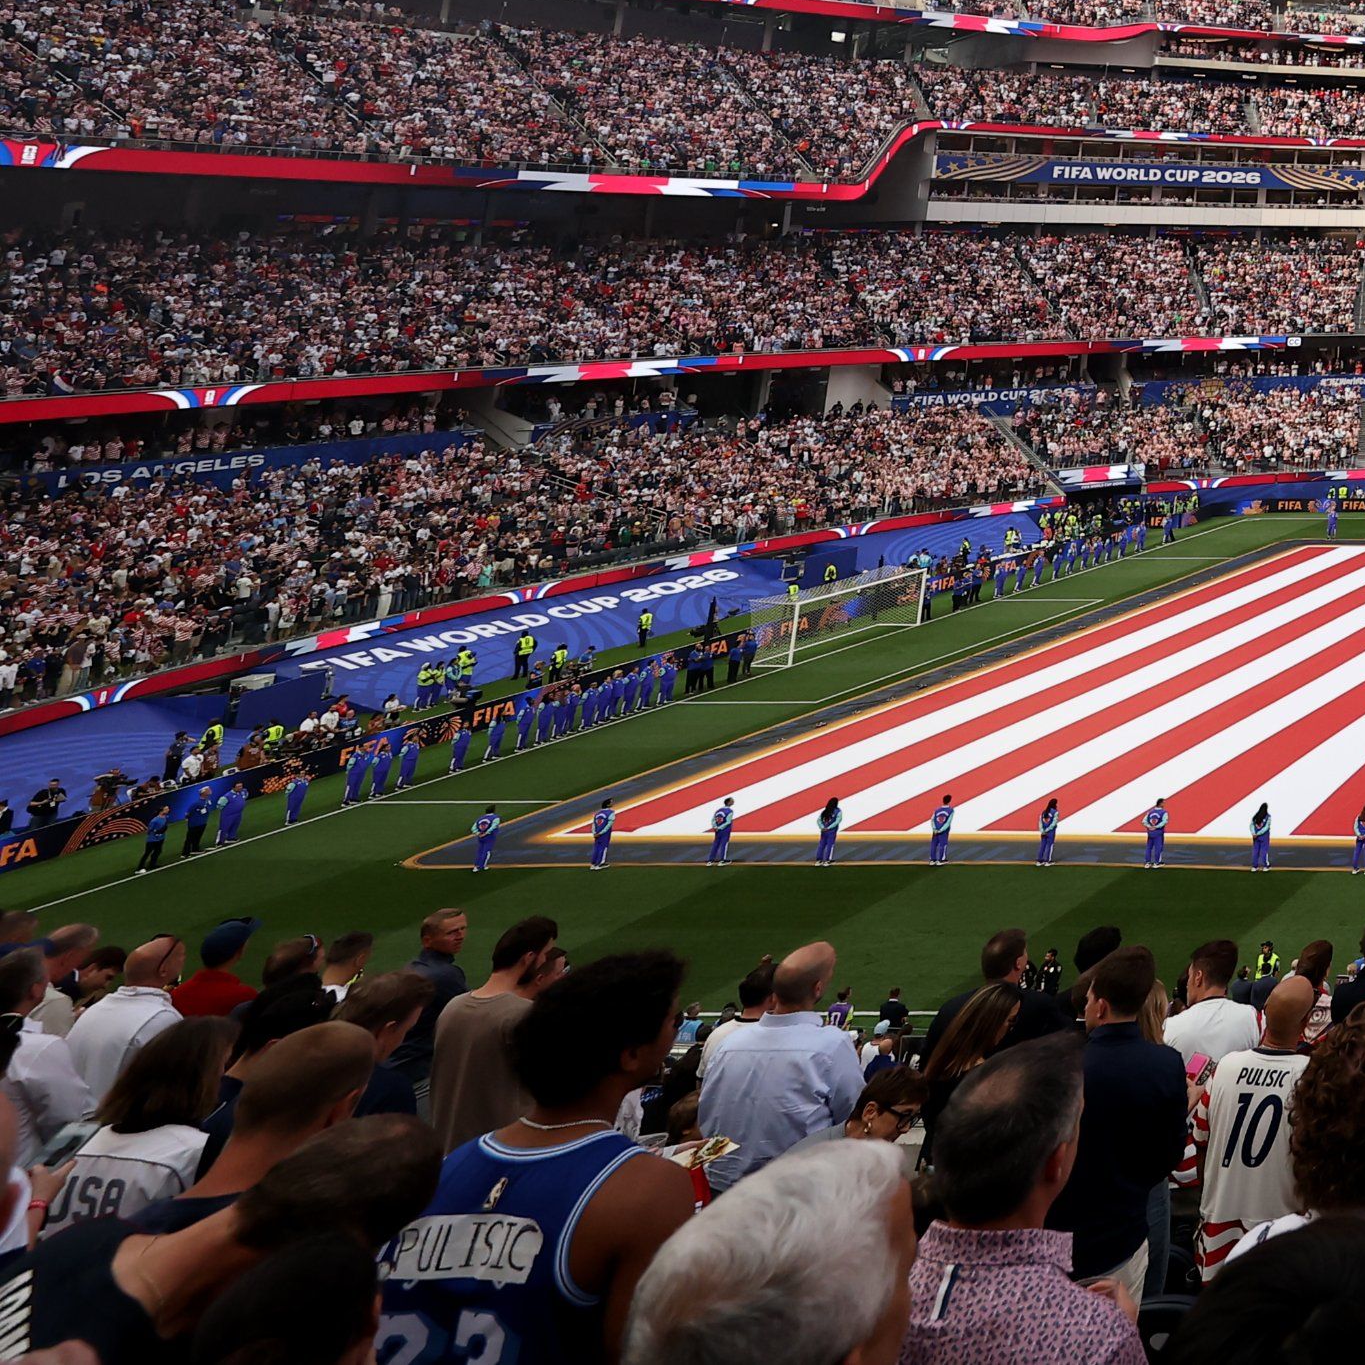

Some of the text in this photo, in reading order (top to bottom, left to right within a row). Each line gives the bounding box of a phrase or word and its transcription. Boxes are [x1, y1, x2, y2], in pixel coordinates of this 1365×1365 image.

[1053, 166, 1261, 183] FIFA WORLD CUP 2026
[914, 394, 944, 406] FIFA
[1278, 501, 1302, 510] FIFA
[1342, 501, 1365, 510] FIFA
[932, 576, 955, 592] FIFA
[298, 566, 741, 672] FIFA WORLD CUP 2026
[1236, 1067, 1290, 1088] PULISIC
[1222, 1092, 1284, 1168] 10
[49, 1175, 126, 1223] USA
[396, 1221, 538, 1276] PULISIC
